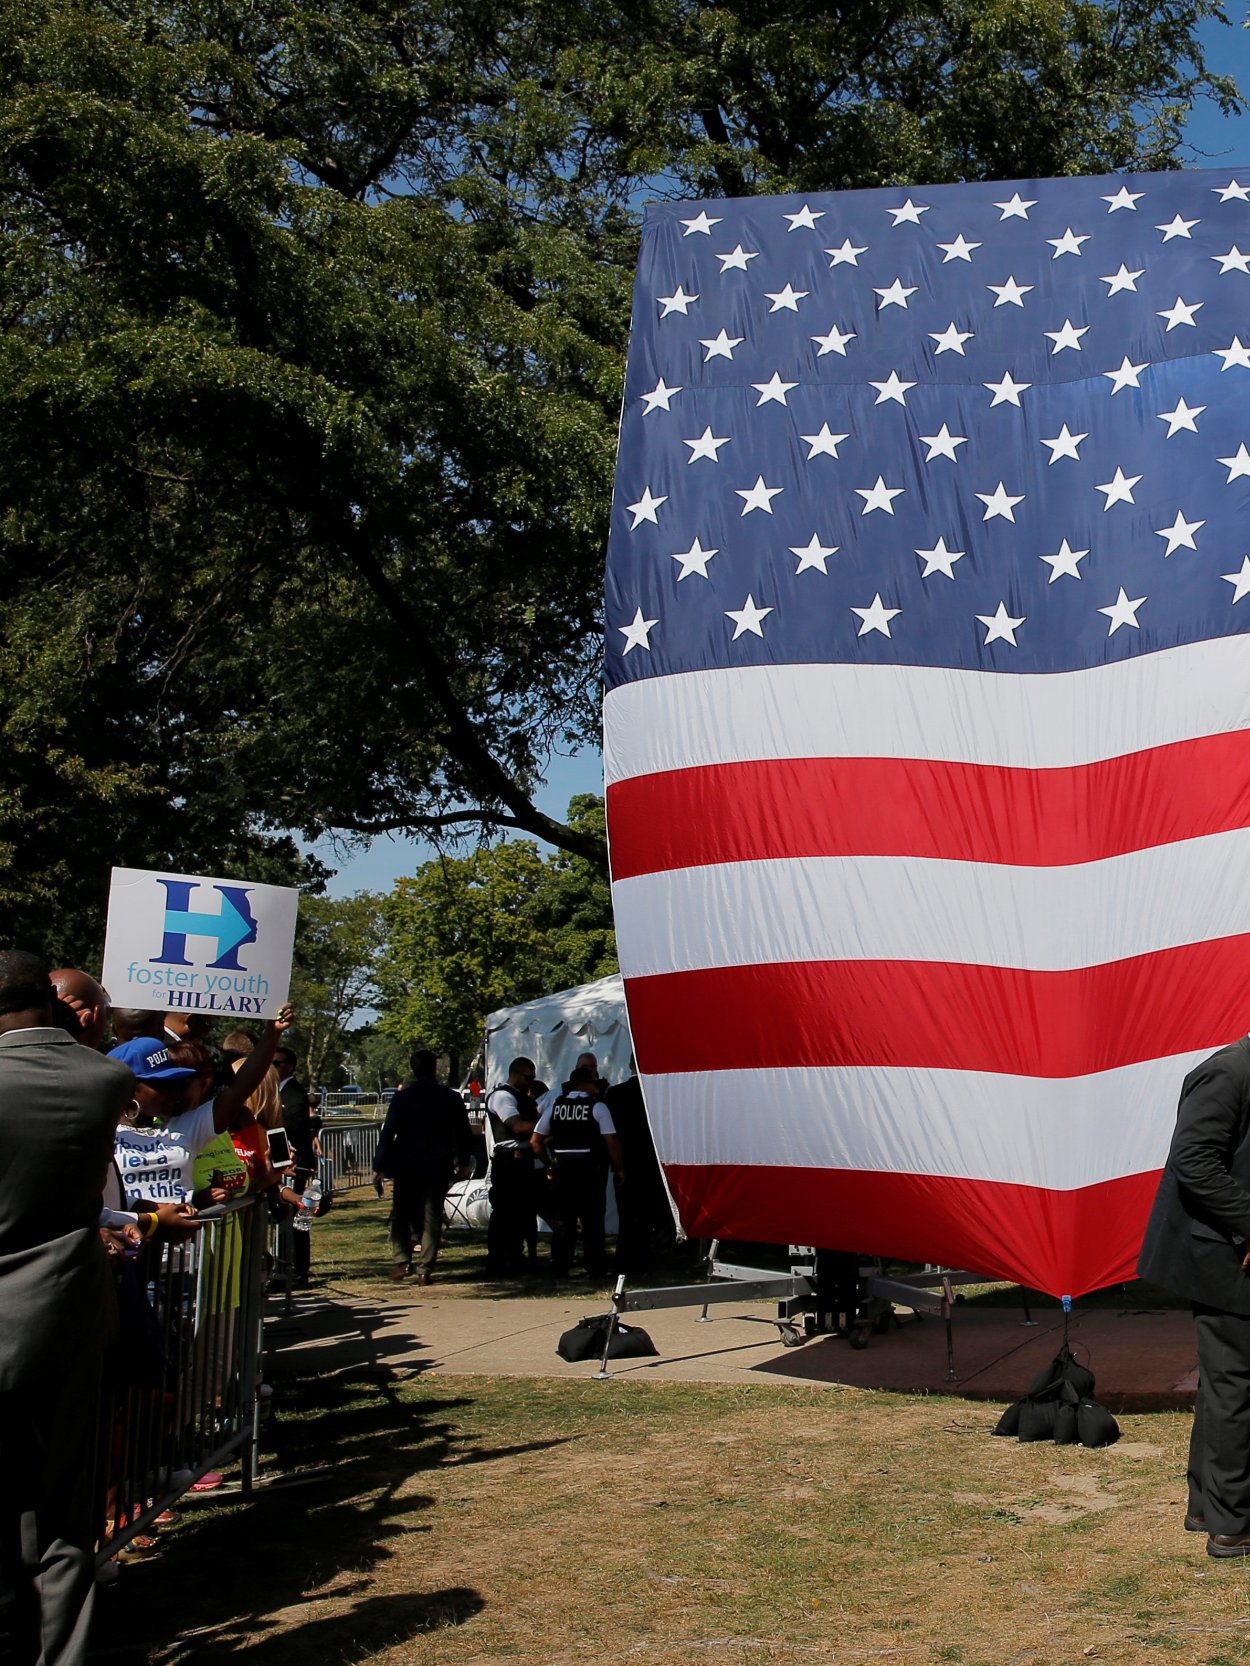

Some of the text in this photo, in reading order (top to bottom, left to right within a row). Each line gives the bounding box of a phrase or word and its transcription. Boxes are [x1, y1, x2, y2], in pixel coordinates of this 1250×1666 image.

[127, 961, 269, 995] foster youth
[152, 989, 267, 1014] for HILLARY
[553, 1104, 589, 1120] POLICE
[157, 1155, 168, 1164] a
[121, 1168, 181, 1184] oman
[149, 1181, 183, 1198] this
